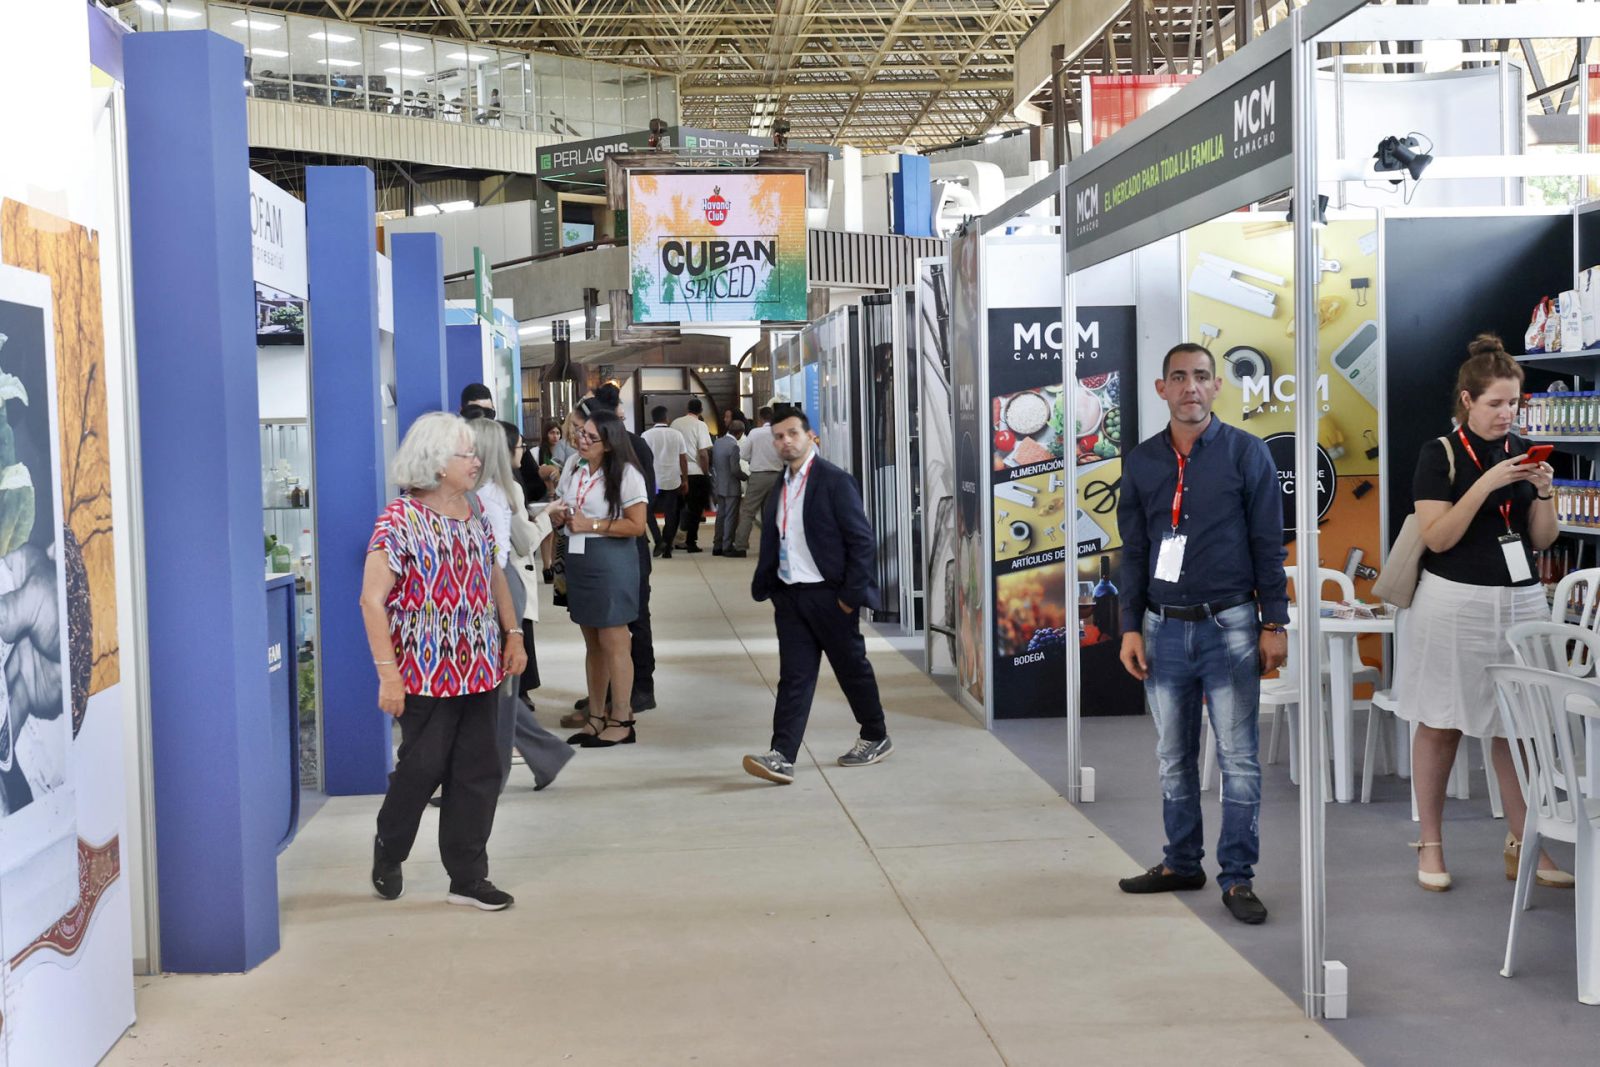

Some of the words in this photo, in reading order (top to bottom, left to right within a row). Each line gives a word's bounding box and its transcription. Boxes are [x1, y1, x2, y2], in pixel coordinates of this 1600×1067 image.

[1234, 80, 1275, 142] MCM
[1233, 131, 1275, 159] CAMACHO
[1104, 191, 1112, 212] EL
[1112, 172, 1140, 208] MERCADO
[1141, 163, 1160, 192] PARA
[1160, 153, 1179, 183] TODA
[1180, 149, 1190, 175] LA
[1191, 133, 1224, 170] FAMILIA
[702, 198, 731, 210] Havana
[1076, 183, 1099, 224] MCM
[707, 210, 725, 222] Club
[1076, 220, 1099, 236] CAMACHO
[662, 240, 776, 277] CUBAN
[684, 264, 756, 299] SPICED
[1013, 321, 1099, 350] MCM
[1013, 351, 1098, 360] CAMAHO
[1242, 404, 1330, 413] CAMAO
[1010, 459, 1064, 479] ALIMENTACIÓN
[1011, 550, 1053, 569] ARTÍCULOS
[1054, 549, 1065, 560] DE
[1014, 651, 1045, 666] BODEGA
